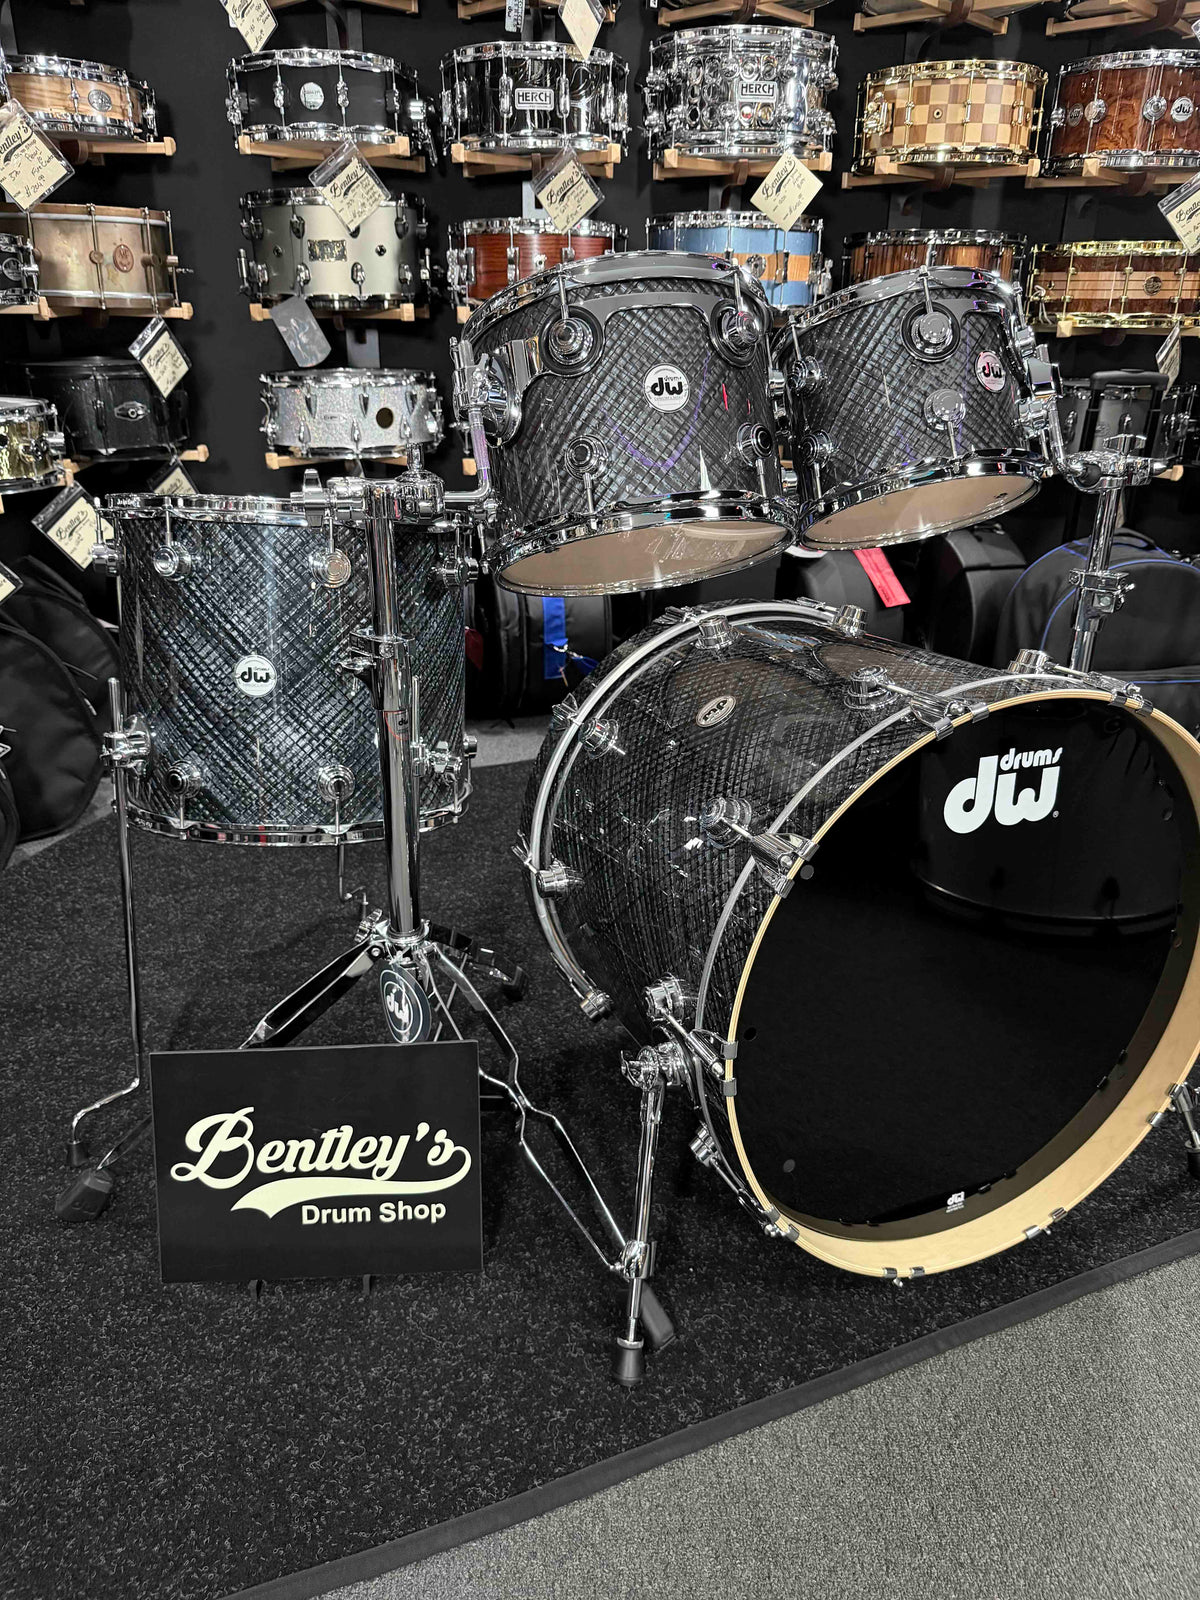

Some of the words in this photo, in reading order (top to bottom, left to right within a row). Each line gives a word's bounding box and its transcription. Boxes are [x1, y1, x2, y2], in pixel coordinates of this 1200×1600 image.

[517, 91, 551, 104] HERCH
[741, 83, 774, 96] HERCH
[0, 124, 29, 154] entley's
[1176, 201, 1200, 223] Bentle
[982, 362, 1002, 378] dw
[650, 376, 683, 396] dw
[240, 667, 270, 683] dw
[999, 747, 1063, 771] drums
[943, 755, 1061, 834] dw
[170, 1106, 457, 1189] Bentley's
[301, 1205, 371, 1225] Drum
[379, 1201, 447, 1223] Shop
